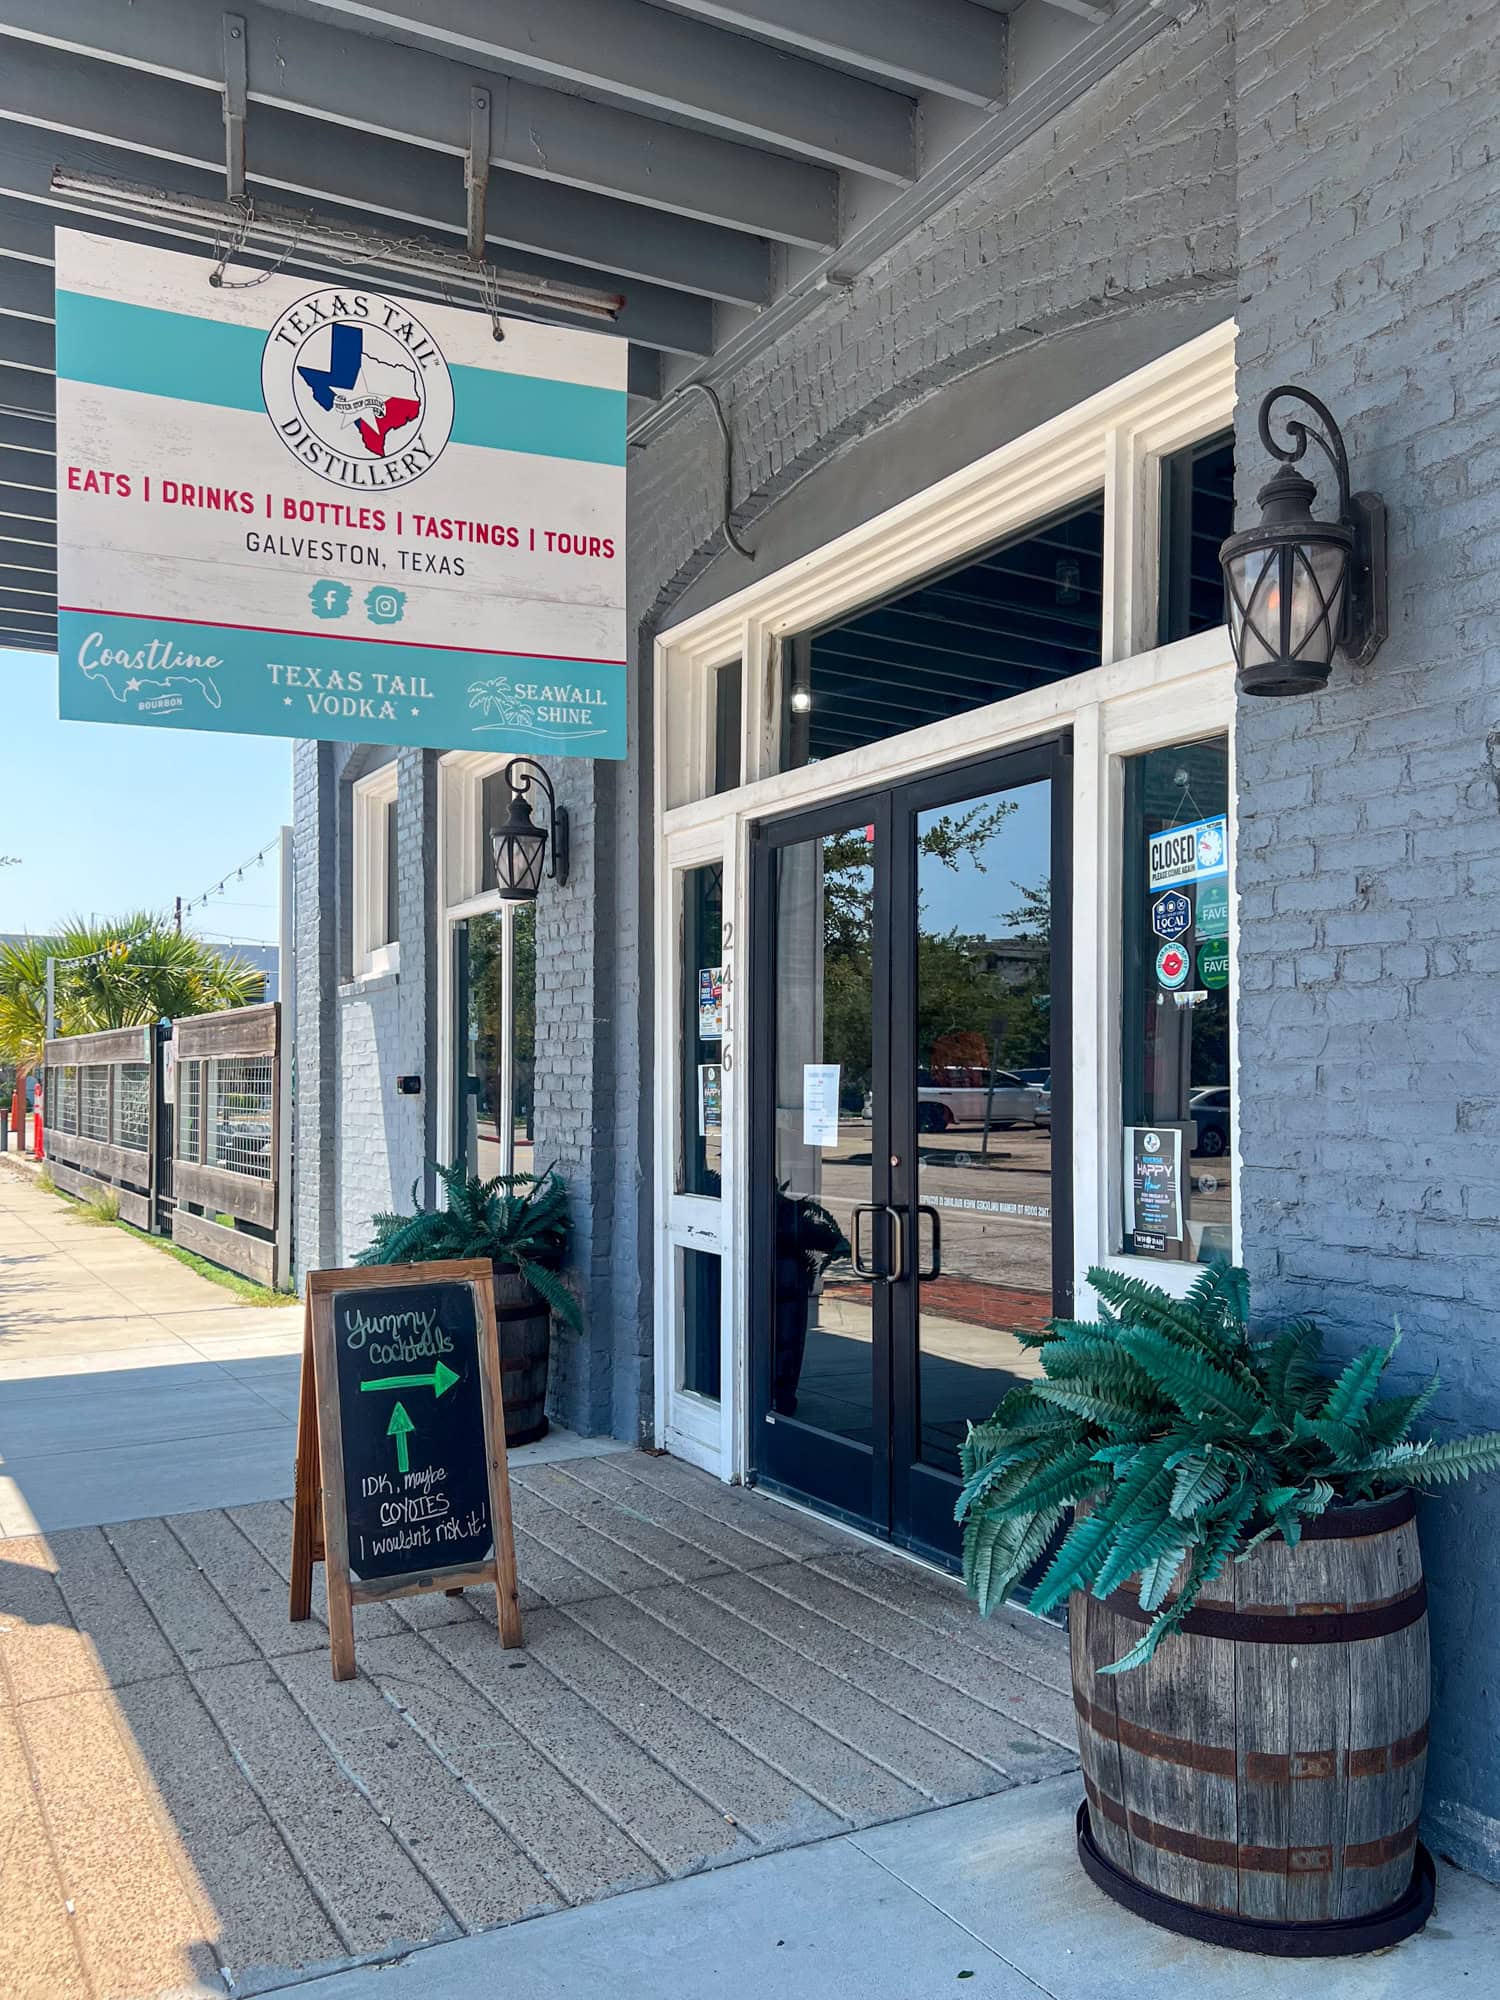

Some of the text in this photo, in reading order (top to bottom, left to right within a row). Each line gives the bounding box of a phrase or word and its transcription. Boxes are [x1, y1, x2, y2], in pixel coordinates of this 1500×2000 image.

[274, 295, 435, 371] TEXAS TAIL
[280, 417, 435, 486] DISTILLERY
[67, 466, 615, 559] EATS DRINKS BOTTLES TASTINGS TOURS
[246, 532, 465, 577] GALVESTON, TEXAS
[77, 631, 224, 670] Coastline
[266, 663, 435, 699] TEXAS TAIL
[514, 683, 607, 706] SEAWALL
[138, 697, 183, 711] BOURBON
[306, 692, 398, 720] VODKA
[536, 706, 593, 725] SHINE
[1152, 834, 1195, 872] CLOSED
[1152, 863, 1196, 882] PLEASE COME AGAIN
[1156, 915, 1185, 930] LOCAL
[1203, 959, 1229, 973] FAVE
[1136, 1163, 1173, 1177] HAPPY
[344, 1307, 437, 1350] Yummy
[404, 1465, 447, 1495] maybe
[380, 1493, 450, 1524] COYOTES
[359, 1535, 365, 1561] I
[435, 1516, 468, 1542] risk
